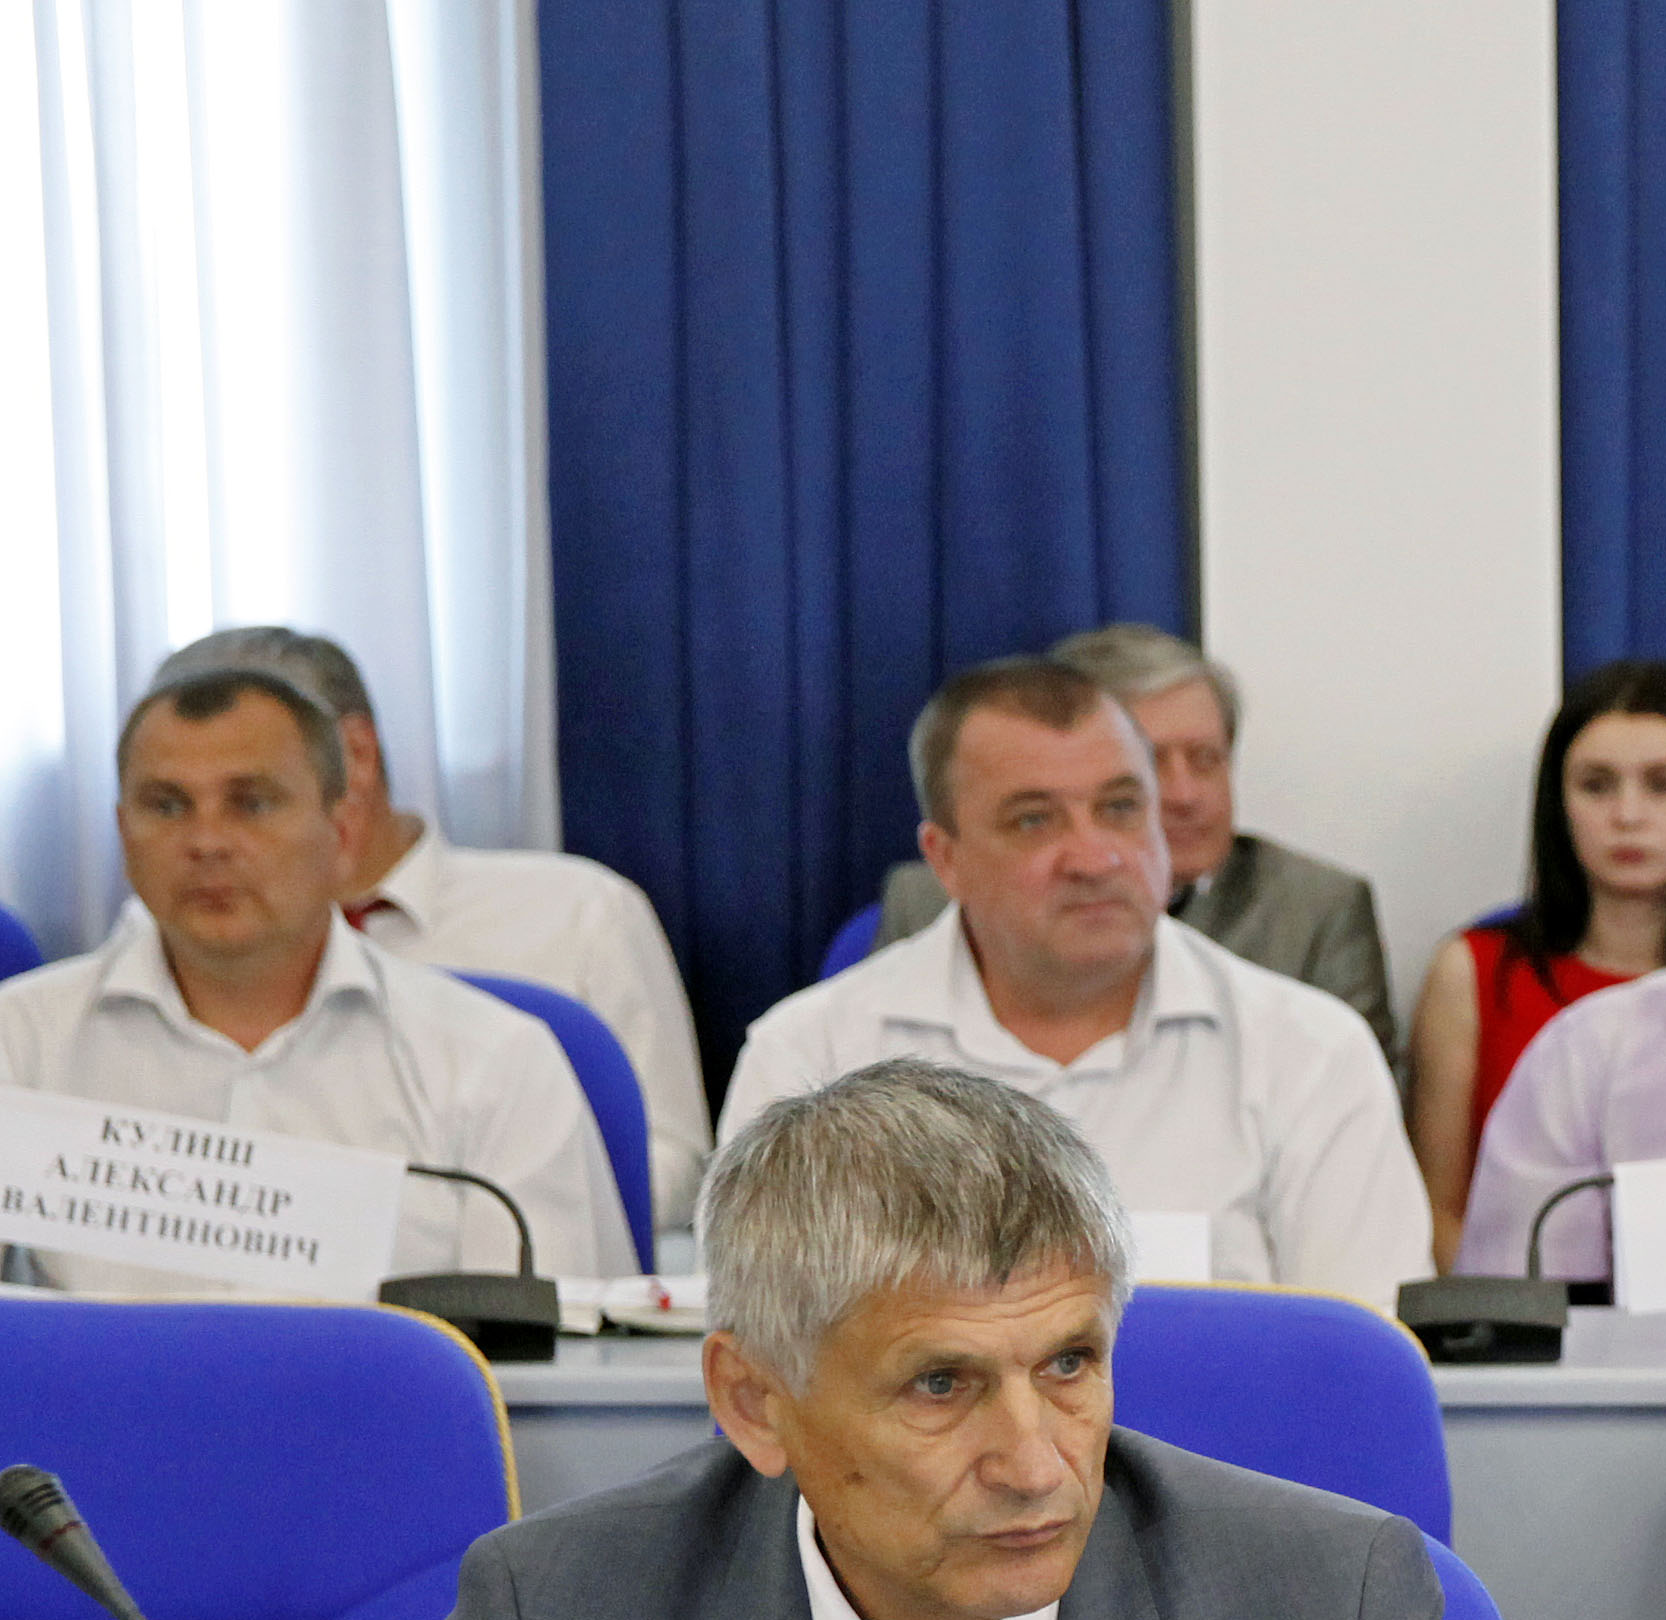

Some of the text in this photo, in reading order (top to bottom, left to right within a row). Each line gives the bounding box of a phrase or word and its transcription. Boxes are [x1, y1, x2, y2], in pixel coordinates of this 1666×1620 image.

[101, 1116, 256, 1167] КУЛИШ
[48, 1153, 293, 1217] АЛЕКСАНДР
[2, 1185, 320, 1265] ВАЛЕНТИНОВИЧ
